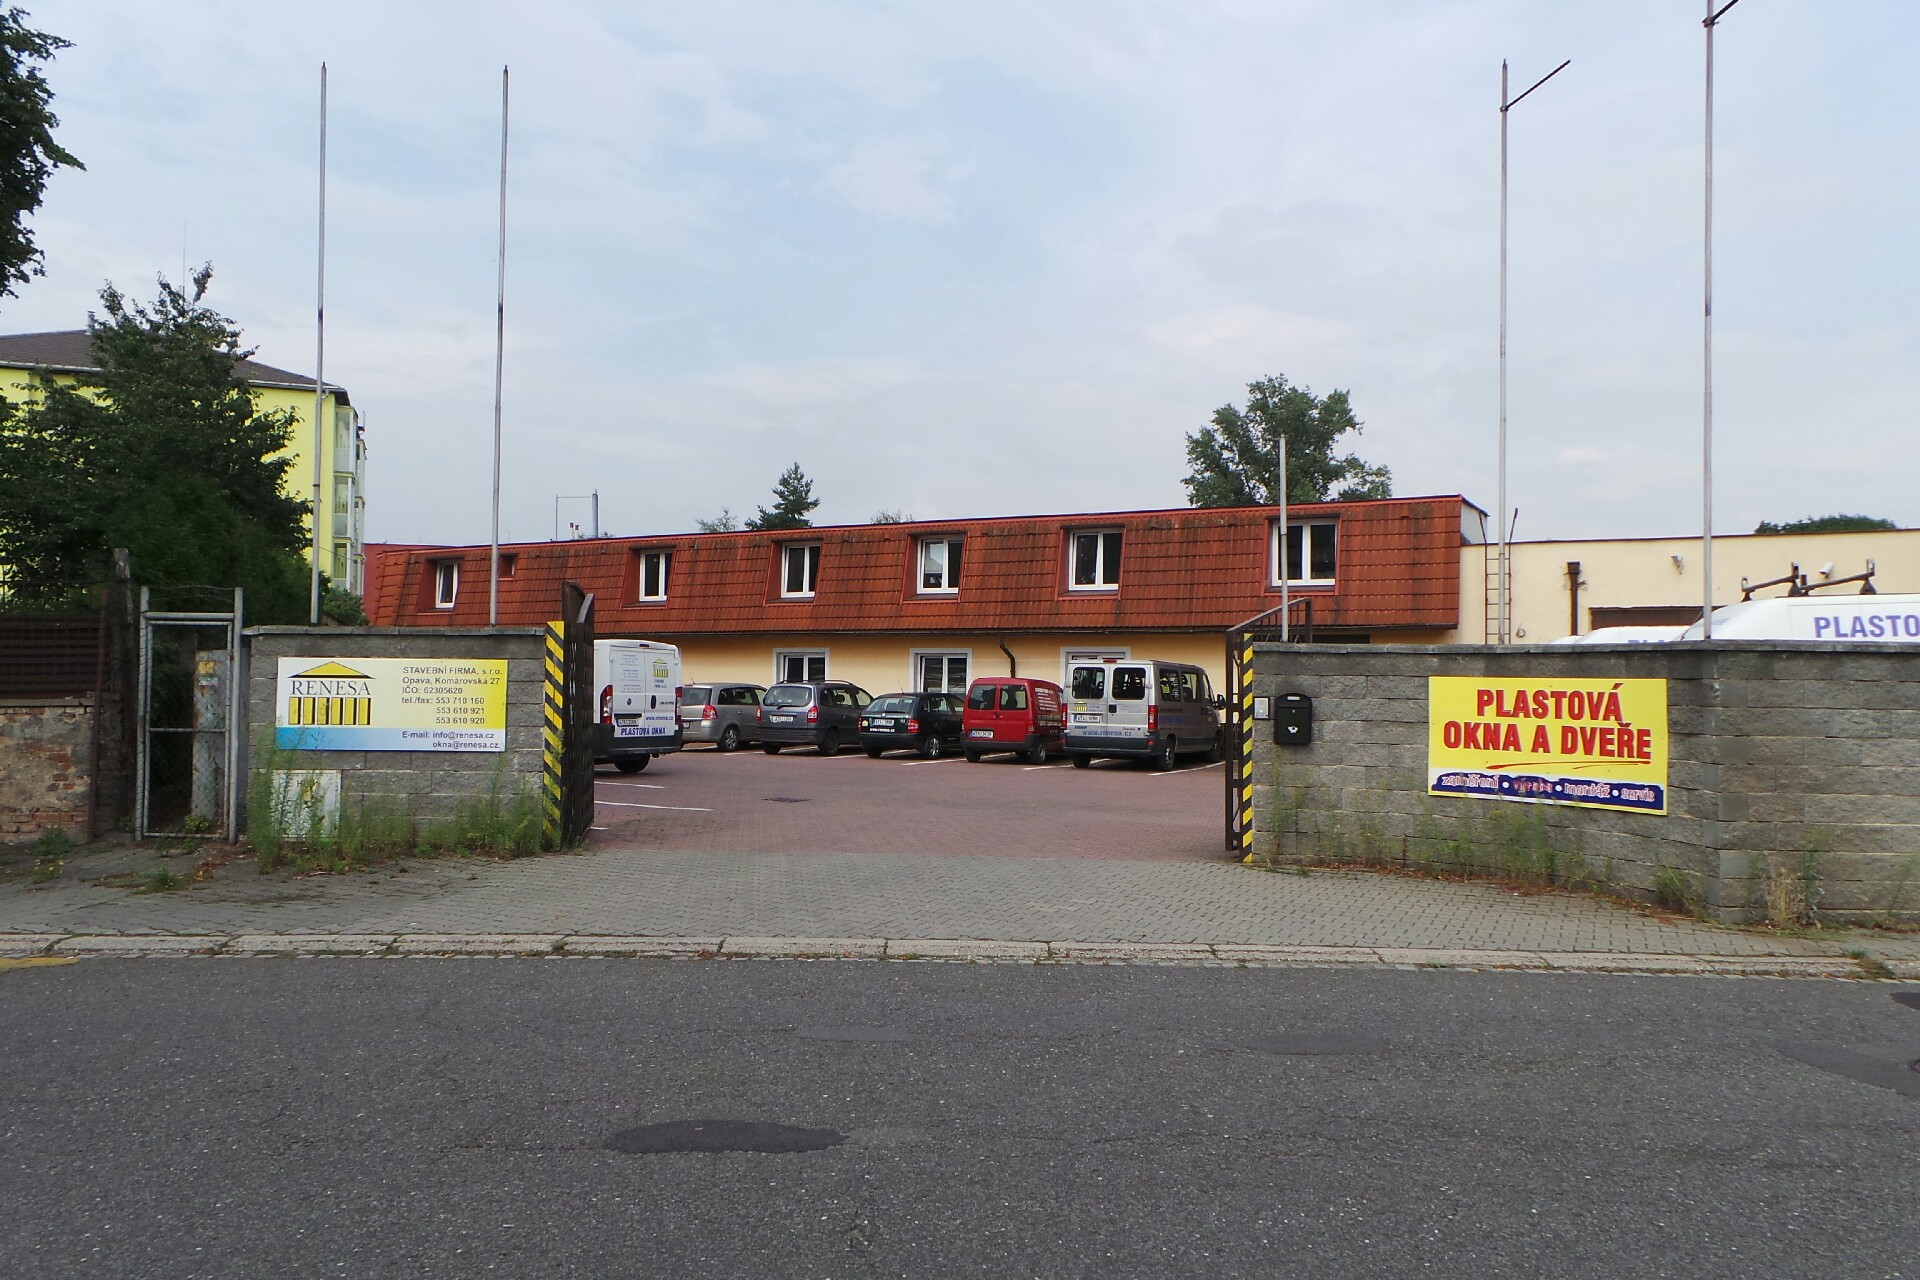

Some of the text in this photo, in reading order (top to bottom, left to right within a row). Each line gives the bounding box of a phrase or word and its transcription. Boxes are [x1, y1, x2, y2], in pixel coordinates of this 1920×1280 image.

[1813, 615, 1920, 638] PLASTO
[403, 665, 447, 675] STAVEBNÍ
[449, 667, 479, 676] FIRMA,
[402, 677, 433, 685] Opava,
[435, 677, 488, 685] Komárovská
[291, 680, 371, 696] RENESA
[402, 685, 421, 694] IČO:
[401, 696, 433, 704] tel./fax:
[1477, 683, 1624, 722] PLASTOVÁ
[453, 707, 468, 715] 610
[470, 707, 485, 715] 921
[402, 731, 495, 740] E-mail: info@renesa.cz
[1443, 720, 1652, 760] OKNA A DVEŘE
[1442, 774, 1500, 788] zaměření
[1564, 783, 1611, 798] montáž
[1620, 788, 1655, 802] servis
